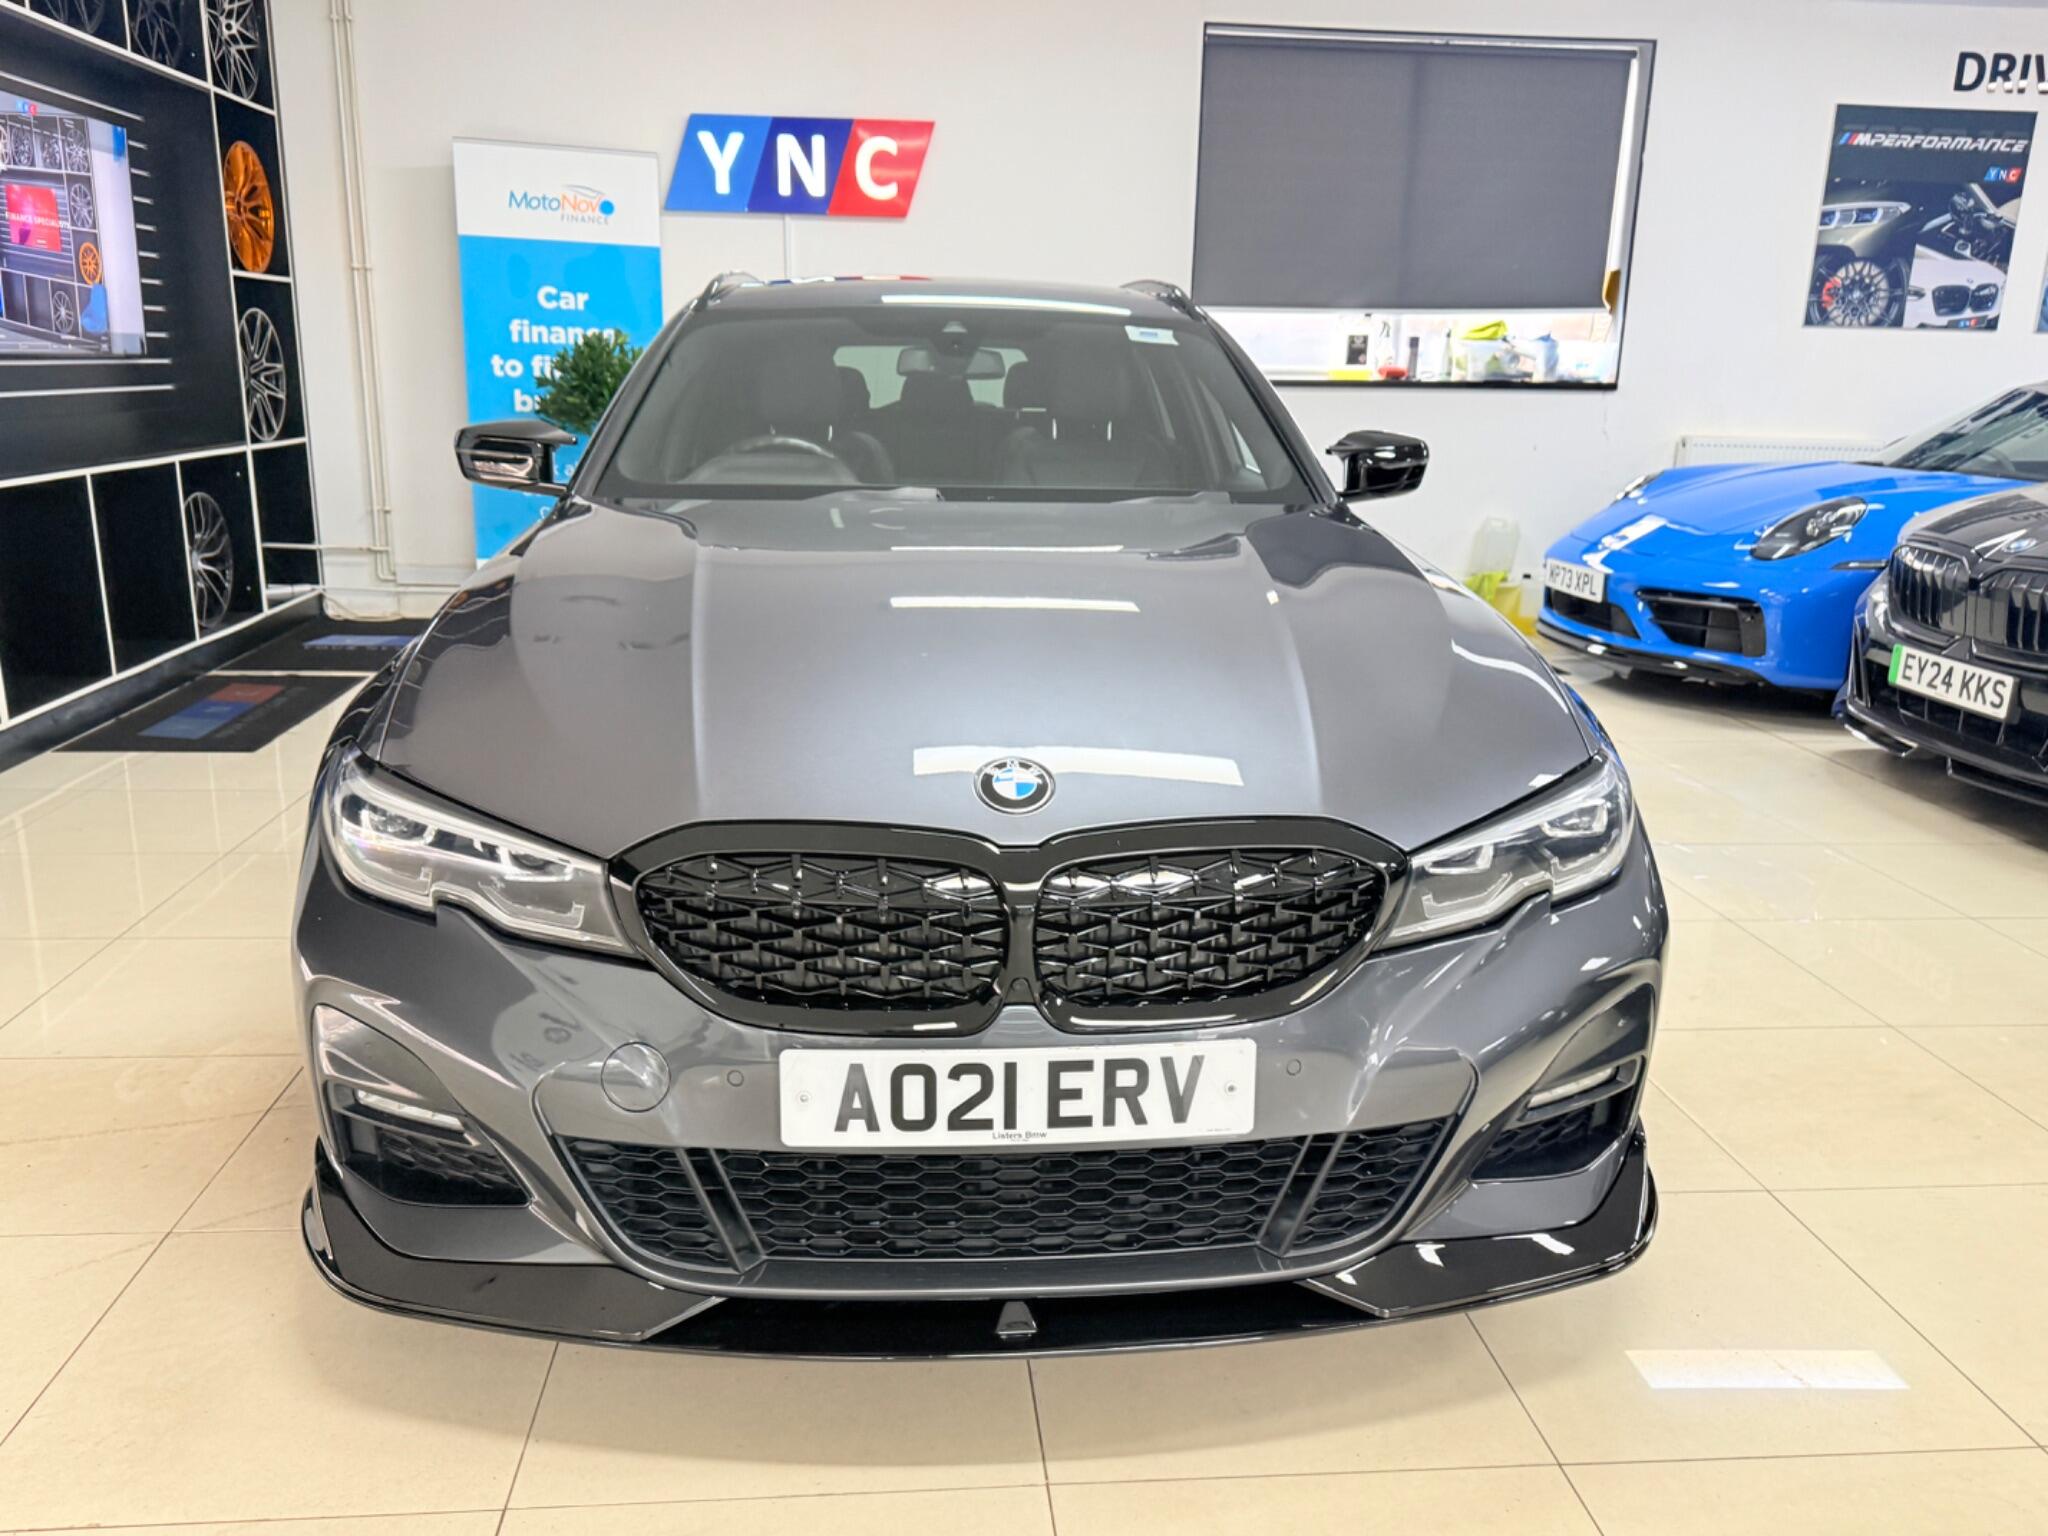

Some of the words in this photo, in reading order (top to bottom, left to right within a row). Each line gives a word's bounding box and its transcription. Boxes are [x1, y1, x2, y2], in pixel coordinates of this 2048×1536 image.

[697, 130, 899, 201] YNC
[537, 285, 590, 311] Car
[509, 319, 615, 347] finan
[490, 353, 524, 378] to
[1574, 570, 1597, 597] XPL
[1901, 652, 1955, 695] EY24
[1958, 668, 2008, 710] KKS
[1046, 1055, 1206, 1129] ERV
